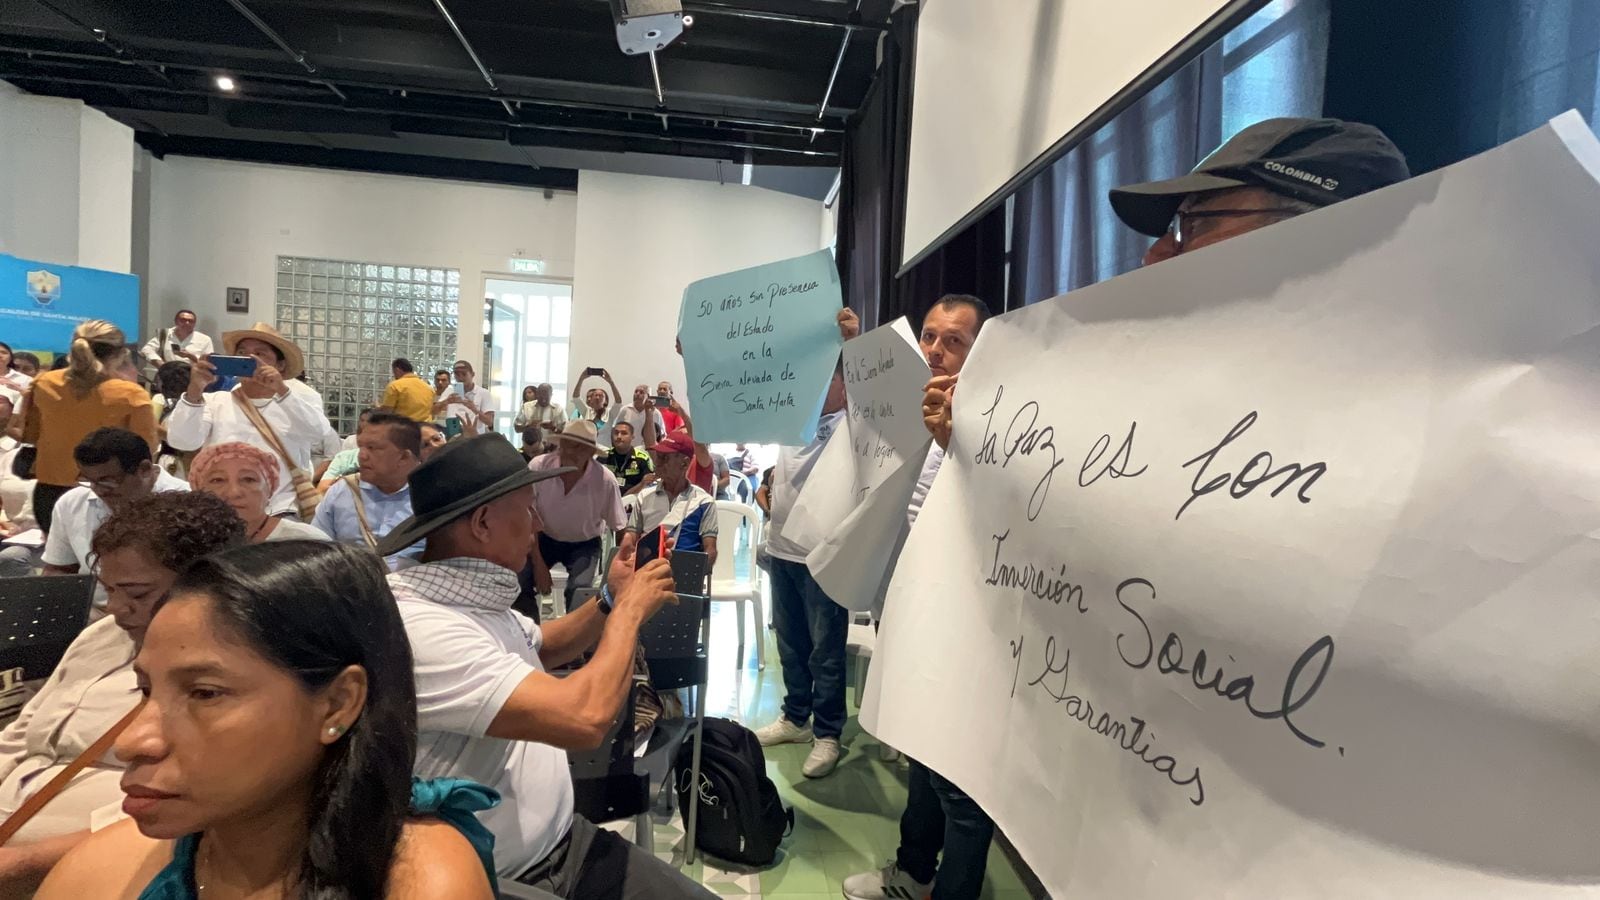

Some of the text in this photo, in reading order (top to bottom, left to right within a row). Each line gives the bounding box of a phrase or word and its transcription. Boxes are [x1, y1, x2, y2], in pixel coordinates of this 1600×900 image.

[1264, 161, 1322, 185] COLOMBIA
[697, 300, 713, 318] 50
[726, 316, 774, 340] del Estado
[742, 342, 773, 361] en la
[739, 370, 773, 386] Nevada
[780, 362, 796, 381] de
[732, 391, 796, 414] Santa Marta
[1001, 400, 1064, 522] Paz
[1078, 421, 1149, 488] es
